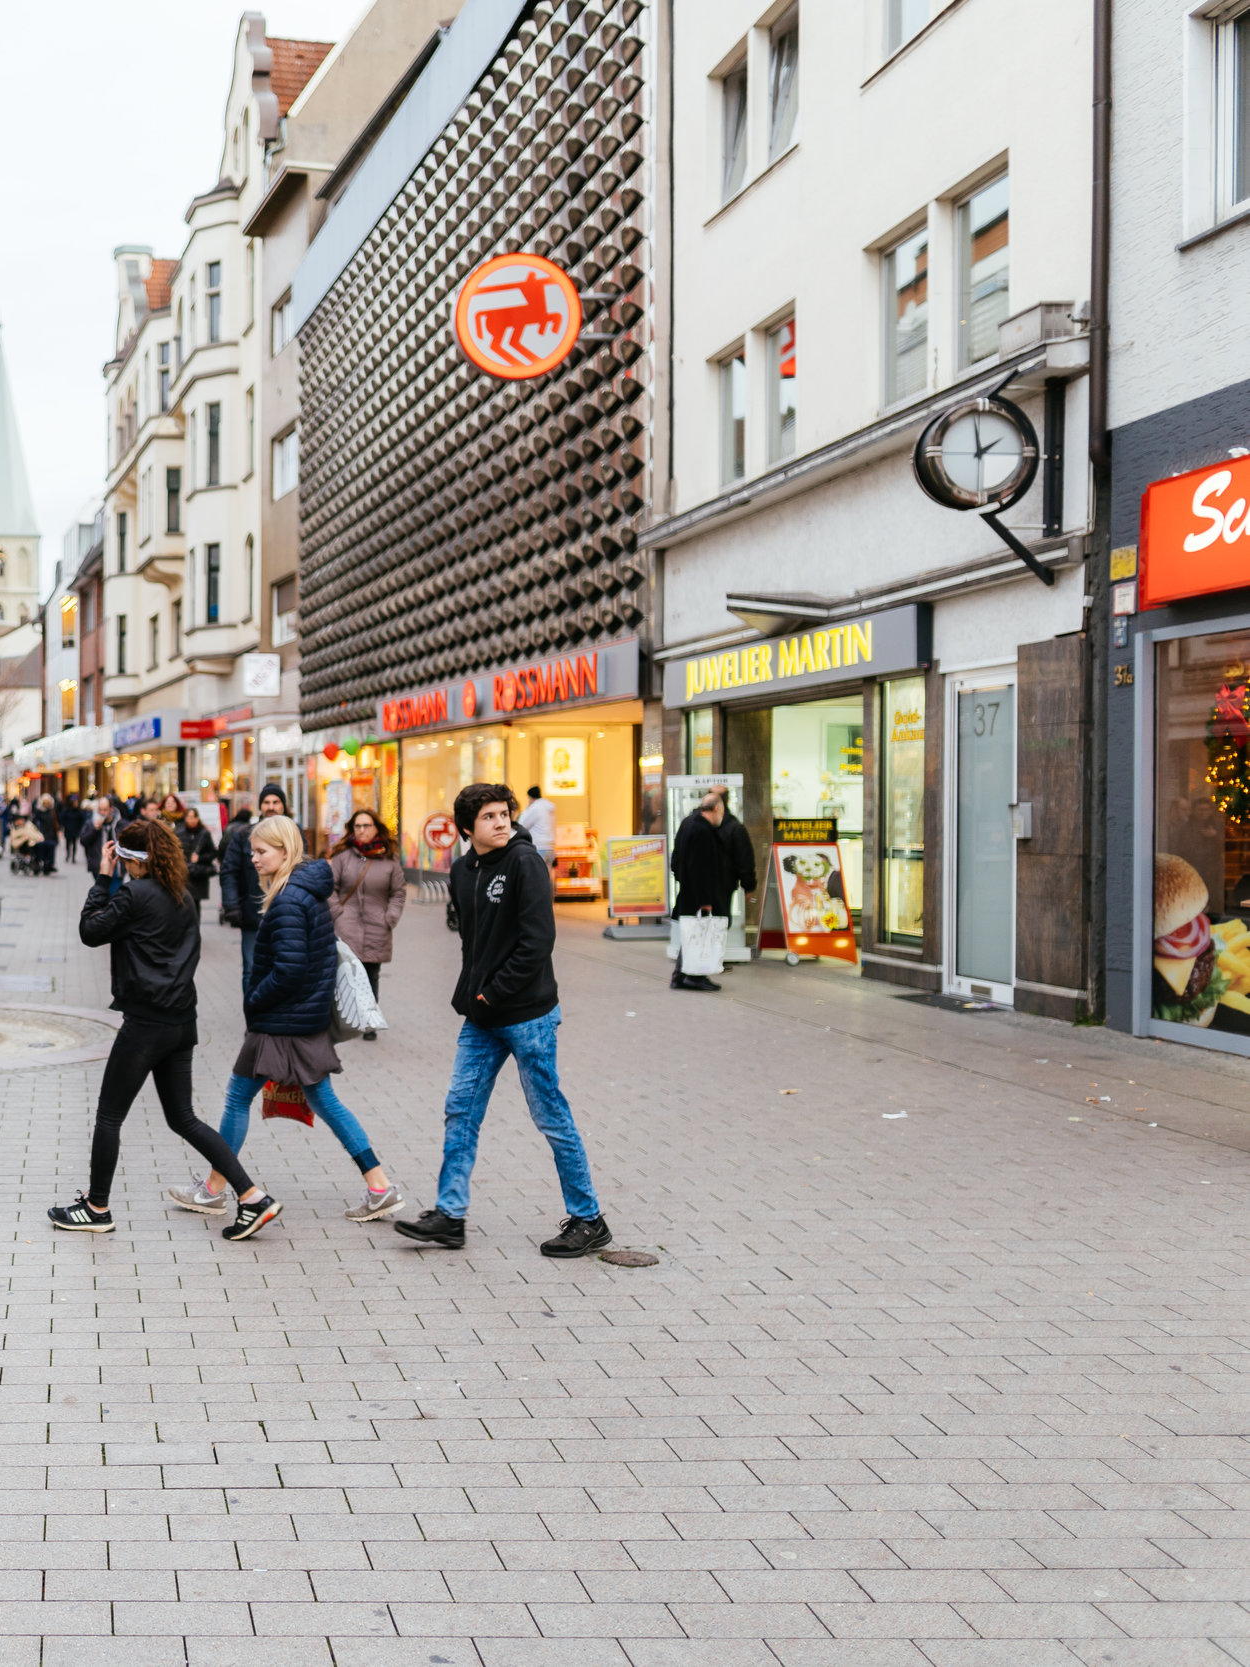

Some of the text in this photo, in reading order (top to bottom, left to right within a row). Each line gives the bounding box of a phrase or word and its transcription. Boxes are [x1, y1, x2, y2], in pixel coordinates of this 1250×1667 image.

[1182, 470, 1250, 552] Sc
[493, 651, 598, 713] ROSSMANN
[686, 620, 872, 702] JUWELIER MARTIN
[382, 688, 448, 733] ROSSMANN
[973, 701, 1001, 737] 37
[777, 820, 834, 831] JUWELIER
[783, 831, 829, 841] MARTIN
